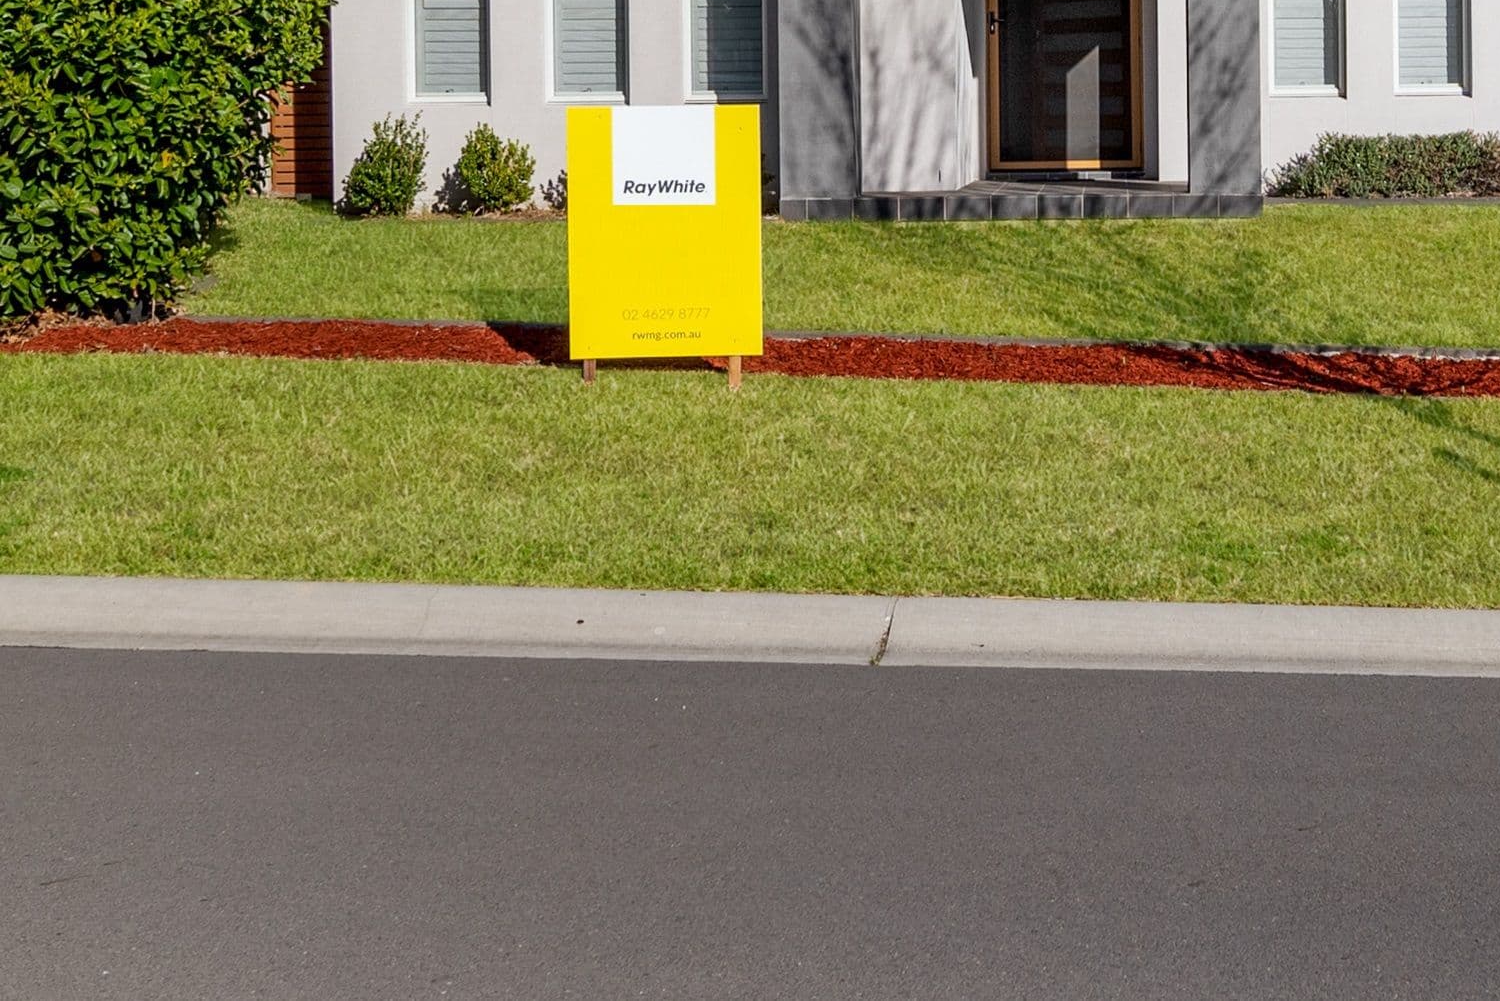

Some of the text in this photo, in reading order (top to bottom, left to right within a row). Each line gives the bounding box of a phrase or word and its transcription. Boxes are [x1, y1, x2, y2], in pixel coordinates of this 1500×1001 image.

[621, 307, 711, 320] 02 4629 8777
[632, 331, 702, 342] rwmg.com.au
